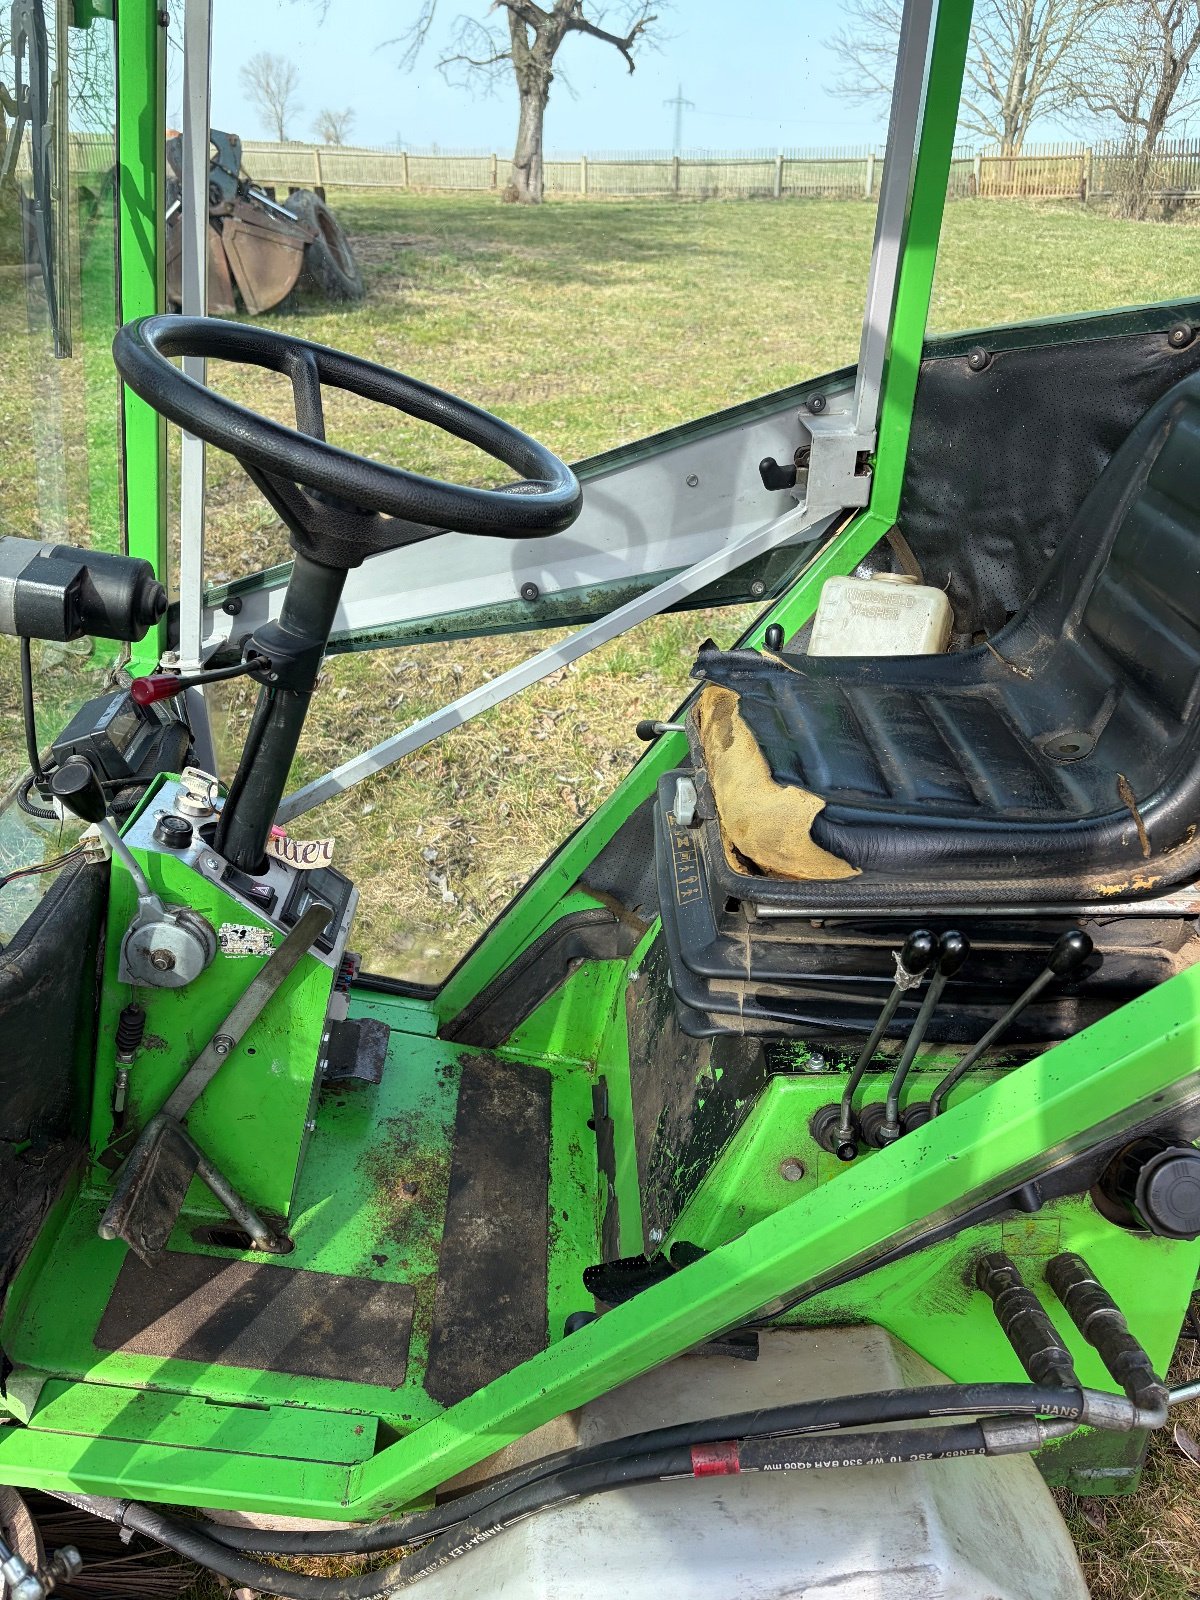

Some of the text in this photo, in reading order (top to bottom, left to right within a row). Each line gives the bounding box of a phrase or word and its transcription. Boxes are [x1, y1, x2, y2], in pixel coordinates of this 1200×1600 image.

[1040, 1404, 1079, 1418] HANS
[814, 1460, 839, 1468] BAR
[842, 1459, 863, 1467] 330
[448, 1523, 504, 1558] HANSA-FLEX
